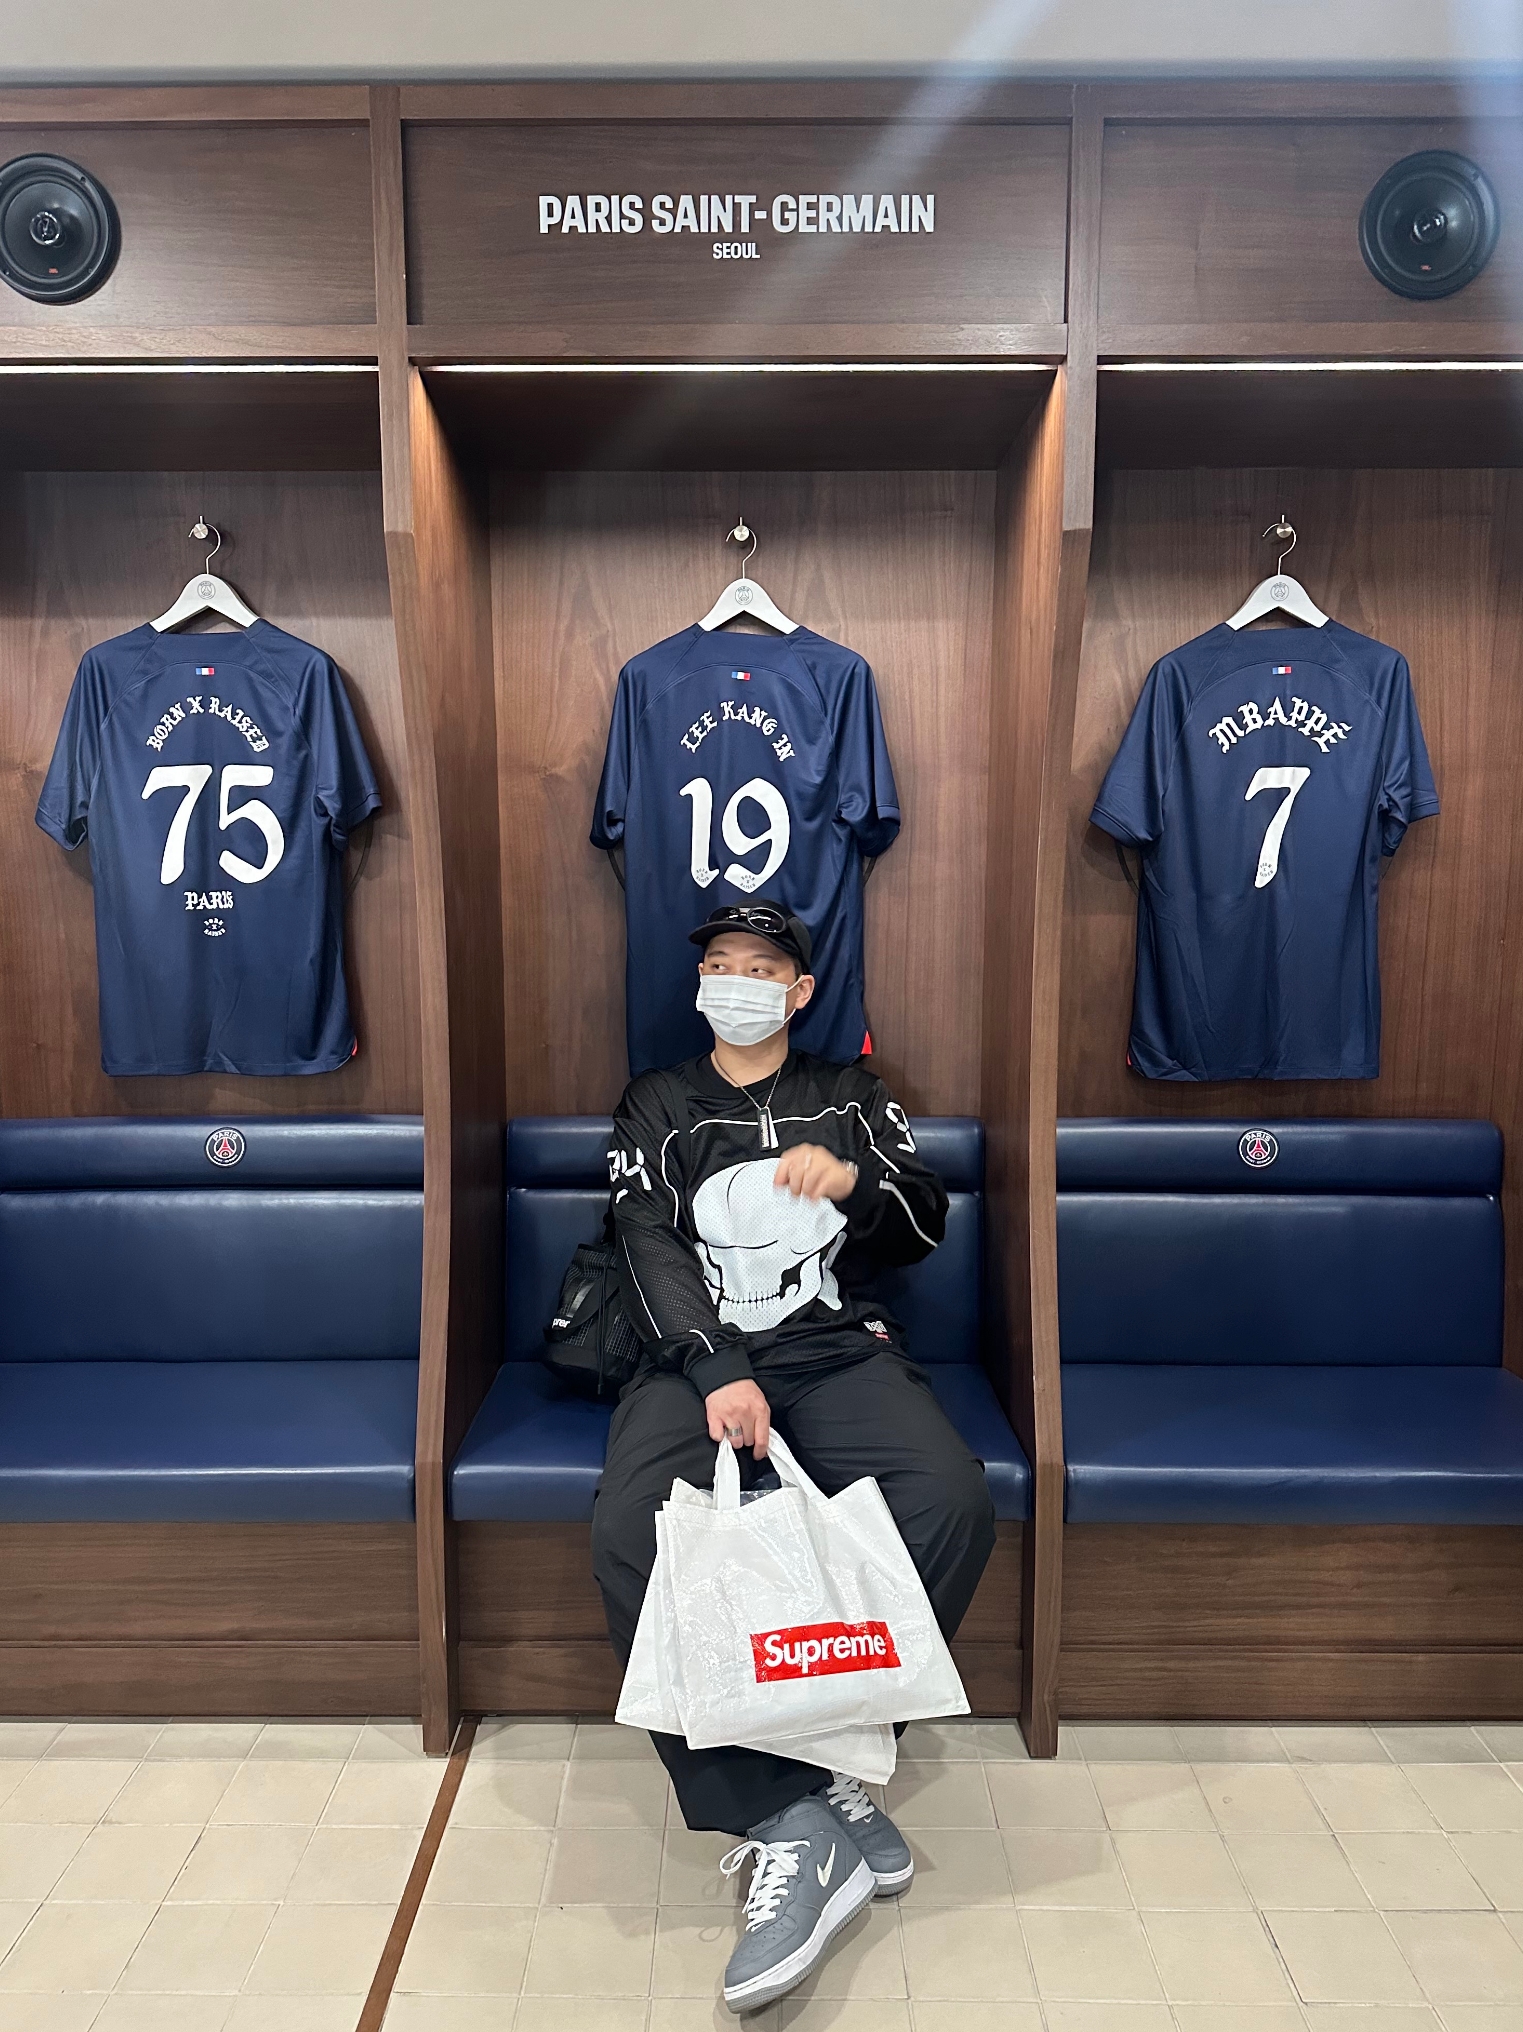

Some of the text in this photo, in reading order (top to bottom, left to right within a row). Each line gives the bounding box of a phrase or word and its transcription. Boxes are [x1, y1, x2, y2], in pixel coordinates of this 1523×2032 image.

[539, 194, 935, 233] PARIS SAINT-GERMAIN
[712, 242, 761, 259] SEOUL
[146, 695, 270, 753] BORN X RAISED
[680, 700, 796, 762] LEE KANG IN
[141, 764, 285, 885] 75
[679, 777, 791, 894] 19
[1244, 766, 1311, 889] 7
[183, 890, 234, 910] PARIS
[212, 1131, 238, 1141] PARIS
[1245, 1132, 1271, 1142] PARIS
[763, 1633, 887, 1674] Supreme
